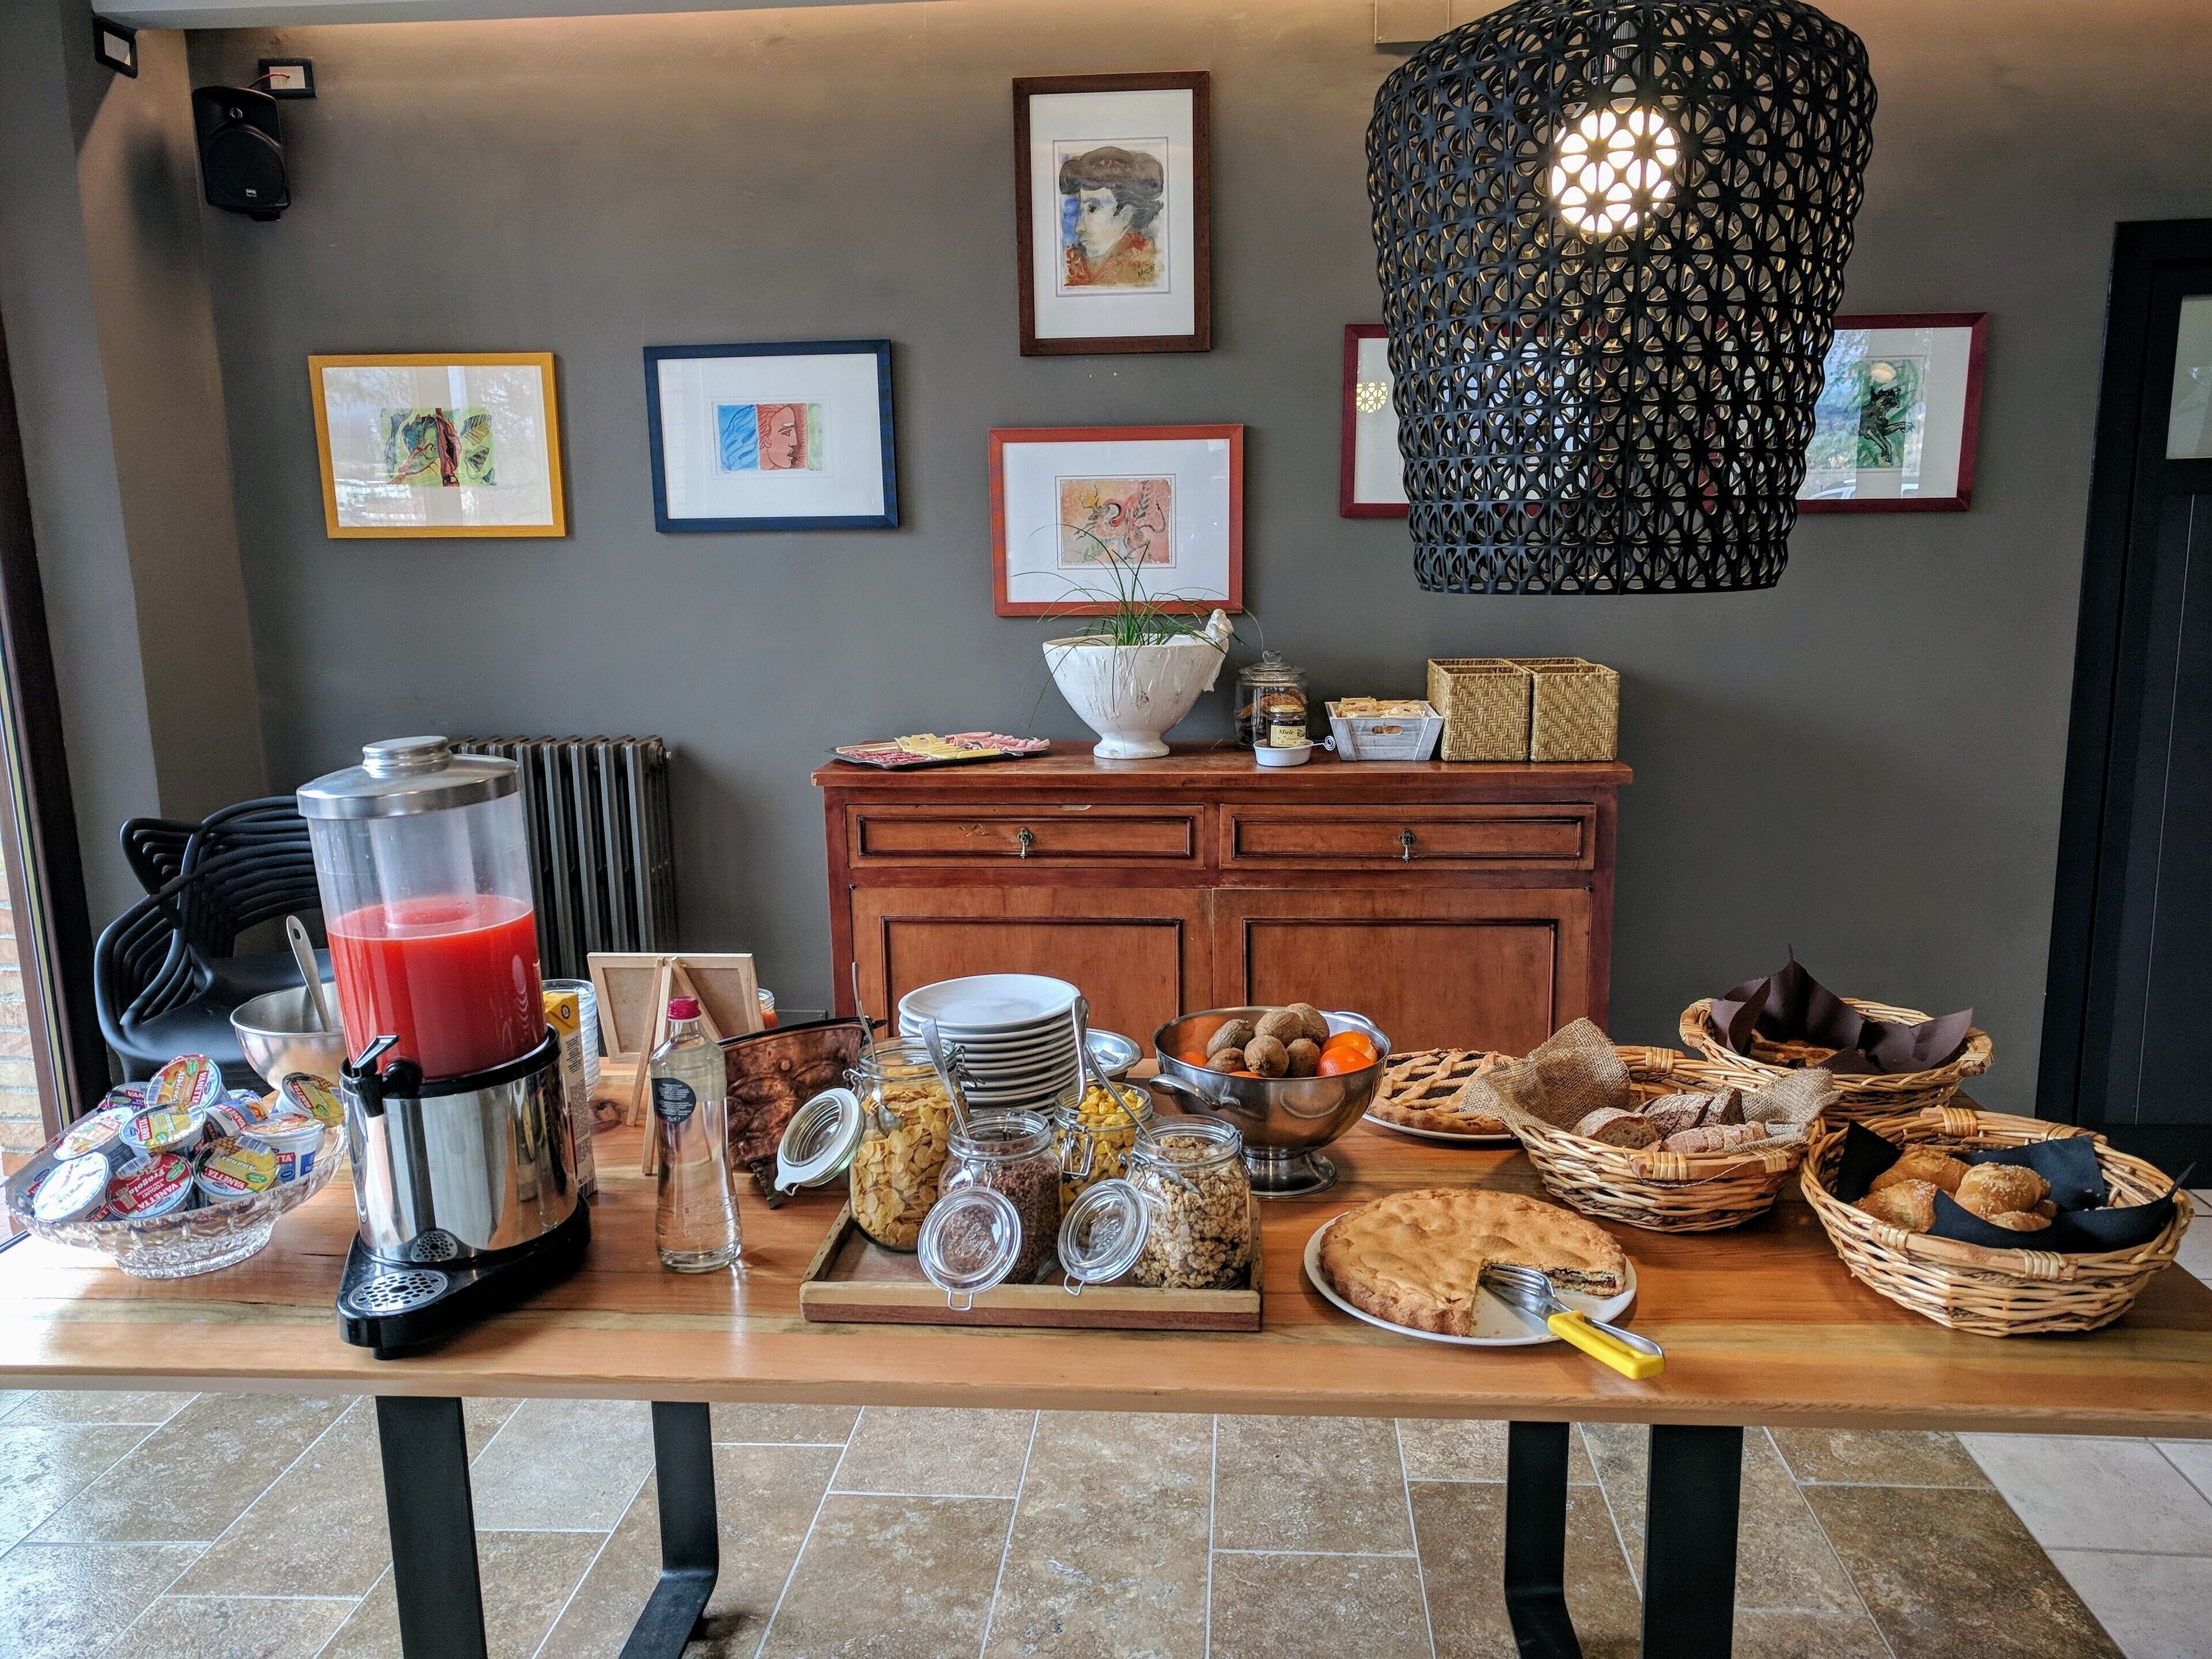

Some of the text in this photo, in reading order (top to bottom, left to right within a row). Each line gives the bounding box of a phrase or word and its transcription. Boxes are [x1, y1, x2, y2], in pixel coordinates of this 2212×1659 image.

[191, 1070, 209, 1103] VANETTA
[221, 1156, 257, 1171] Ananas
[128, 1168, 165, 1195] Fragola
[142, 1183, 165, 1199] YOGURT
[209, 1169, 245, 1190] VANETTA
[137, 1183, 179, 1209] VANETTA
